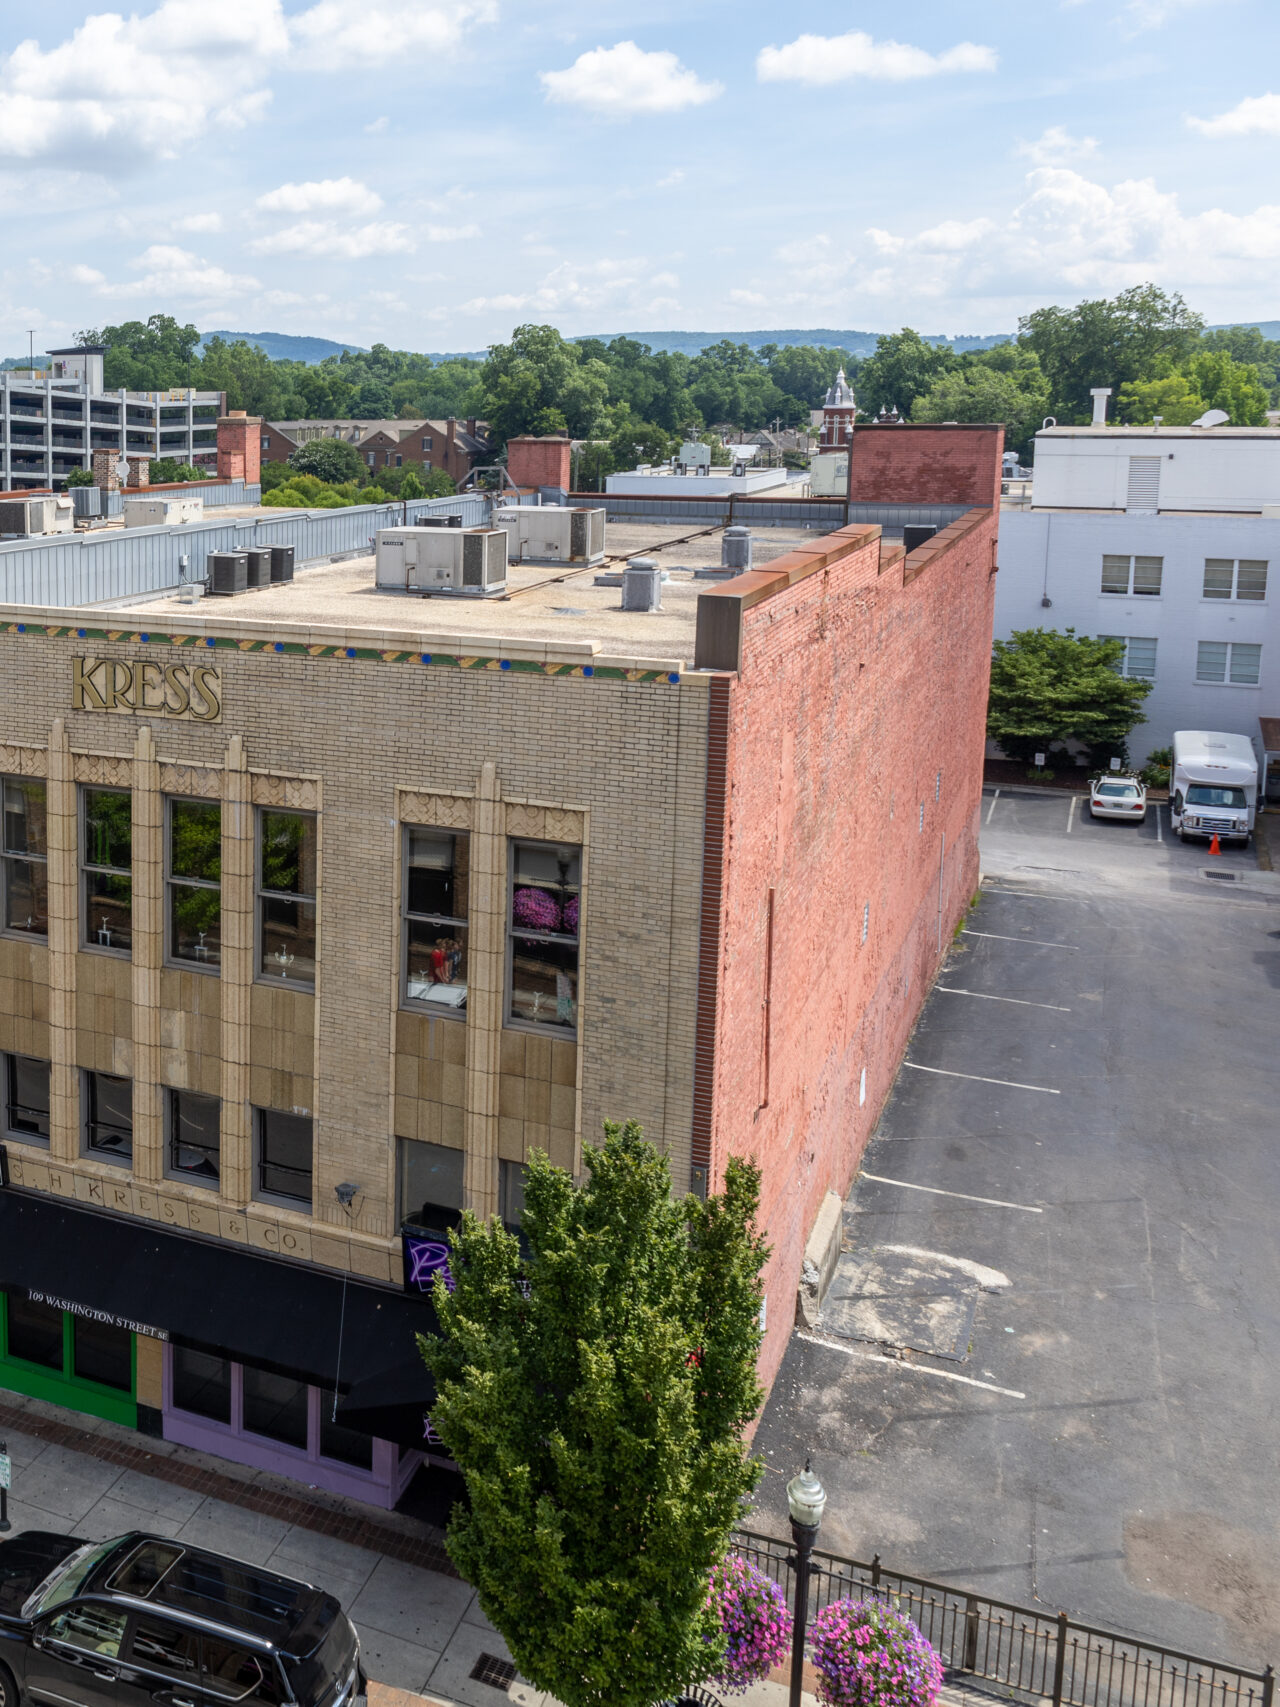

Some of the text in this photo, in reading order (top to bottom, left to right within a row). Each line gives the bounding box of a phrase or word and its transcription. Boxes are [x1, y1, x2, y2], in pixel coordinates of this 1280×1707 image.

[72, 656, 220, 720] KRESS
[88, 1183, 201, 1224] KRESS
[229, 1220, 242, 1234] &
[263, 1229, 305, 1252] CO.
[28, 1289, 168, 1341] 109 WASHINGTON STREET SE
